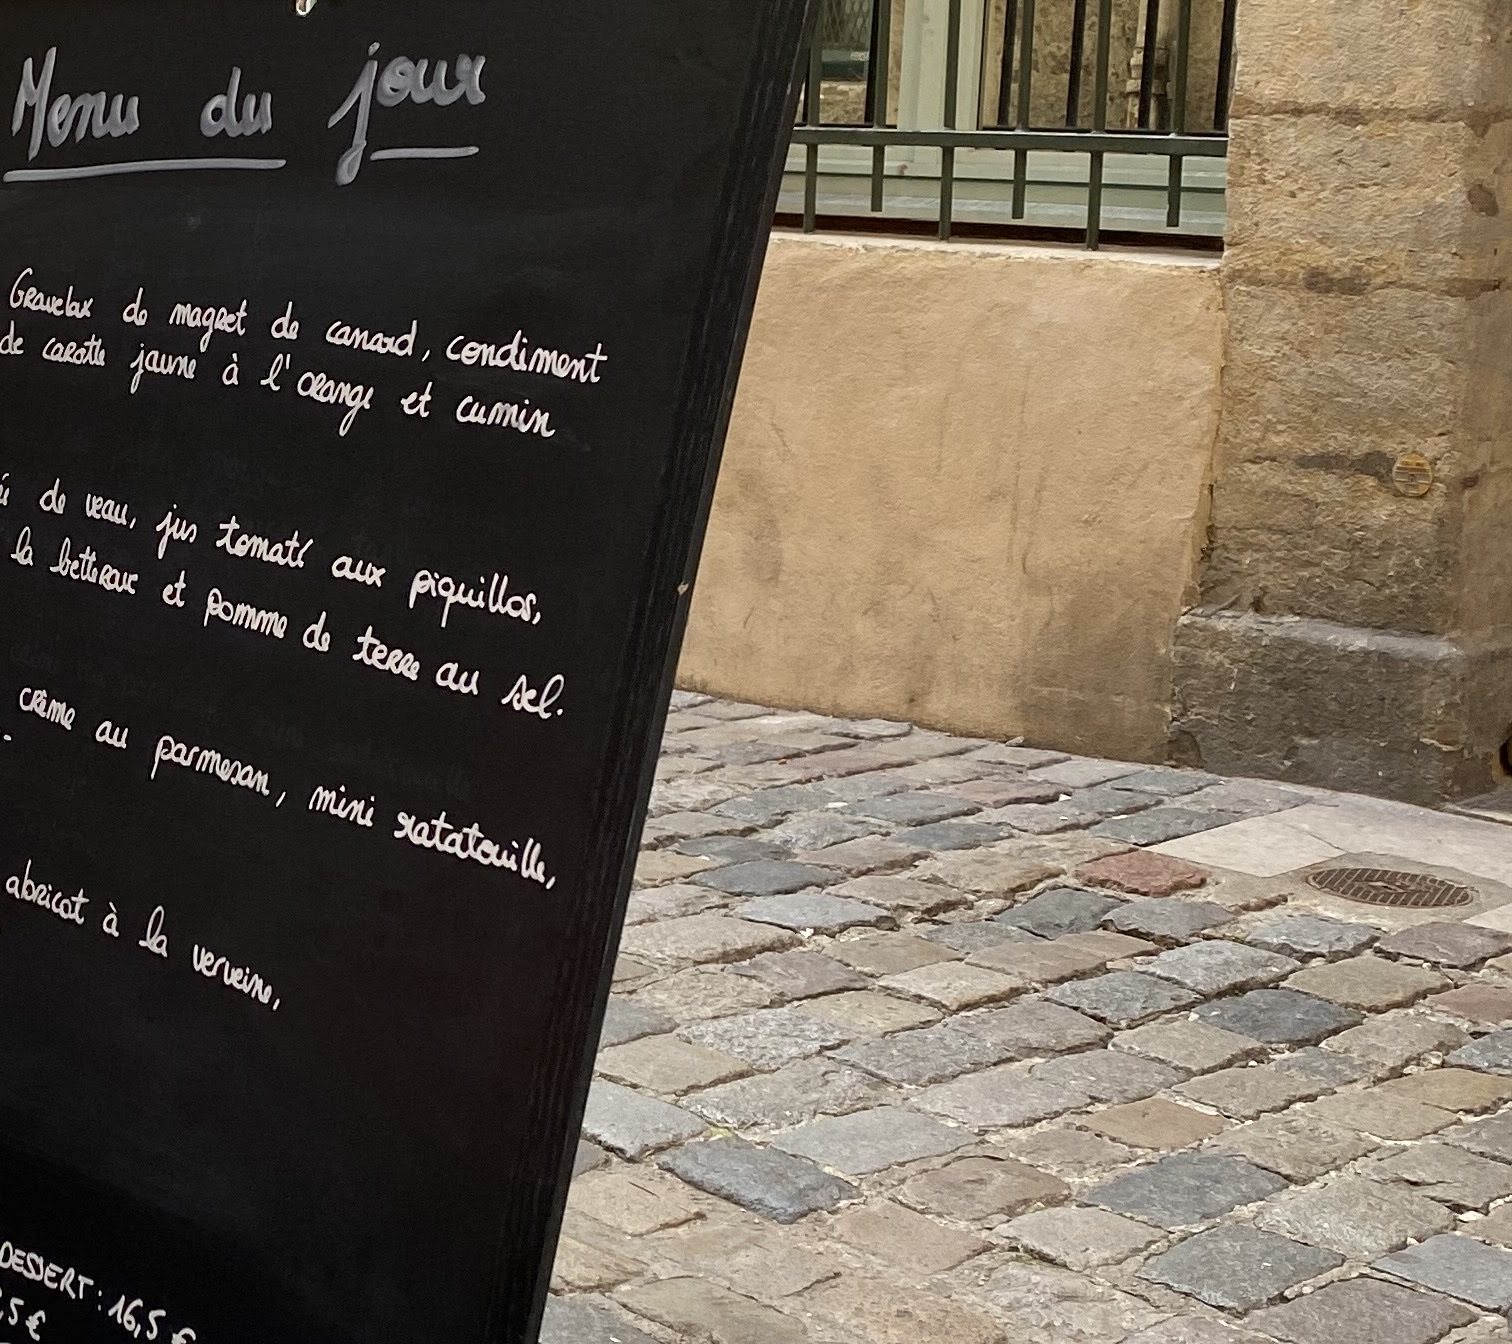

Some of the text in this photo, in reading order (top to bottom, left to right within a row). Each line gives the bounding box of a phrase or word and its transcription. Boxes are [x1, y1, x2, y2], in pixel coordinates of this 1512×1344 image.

[11, 46, 140, 161] Menu
[200, 66, 273, 137] du
[327, 41, 486, 185] jour
[122, 286, 148, 326] de
[168, 299, 248, 353] magret
[270, 300, 300, 340] de
[445, 329, 609, 384] condiment
[129, 342, 197, 395] jaune
[221, 352, 239, 386] à
[400, 381, 433, 418] et
[455, 395, 556, 438] cumin
[39, 477, 66, 515] de
[155, 503, 198, 560] jus
[215, 515, 314, 569] tomaté
[331, 555, 387, 588] aux
[10, 525, 34, 567] la
[162, 569, 187, 608] et
[203, 587, 288, 639] pomme
[302, 610, 331, 652] de
[352, 624, 421, 681] terre
[435, 662, 480, 696] au
[19, 687, 76, 731] crème
[95, 720, 129, 750] au
[308, 784, 375, 827] mini
[102, 901, 120, 938] à
[138, 905, 168, 958] la
[107, 1294, 167, 1341] 16,5
